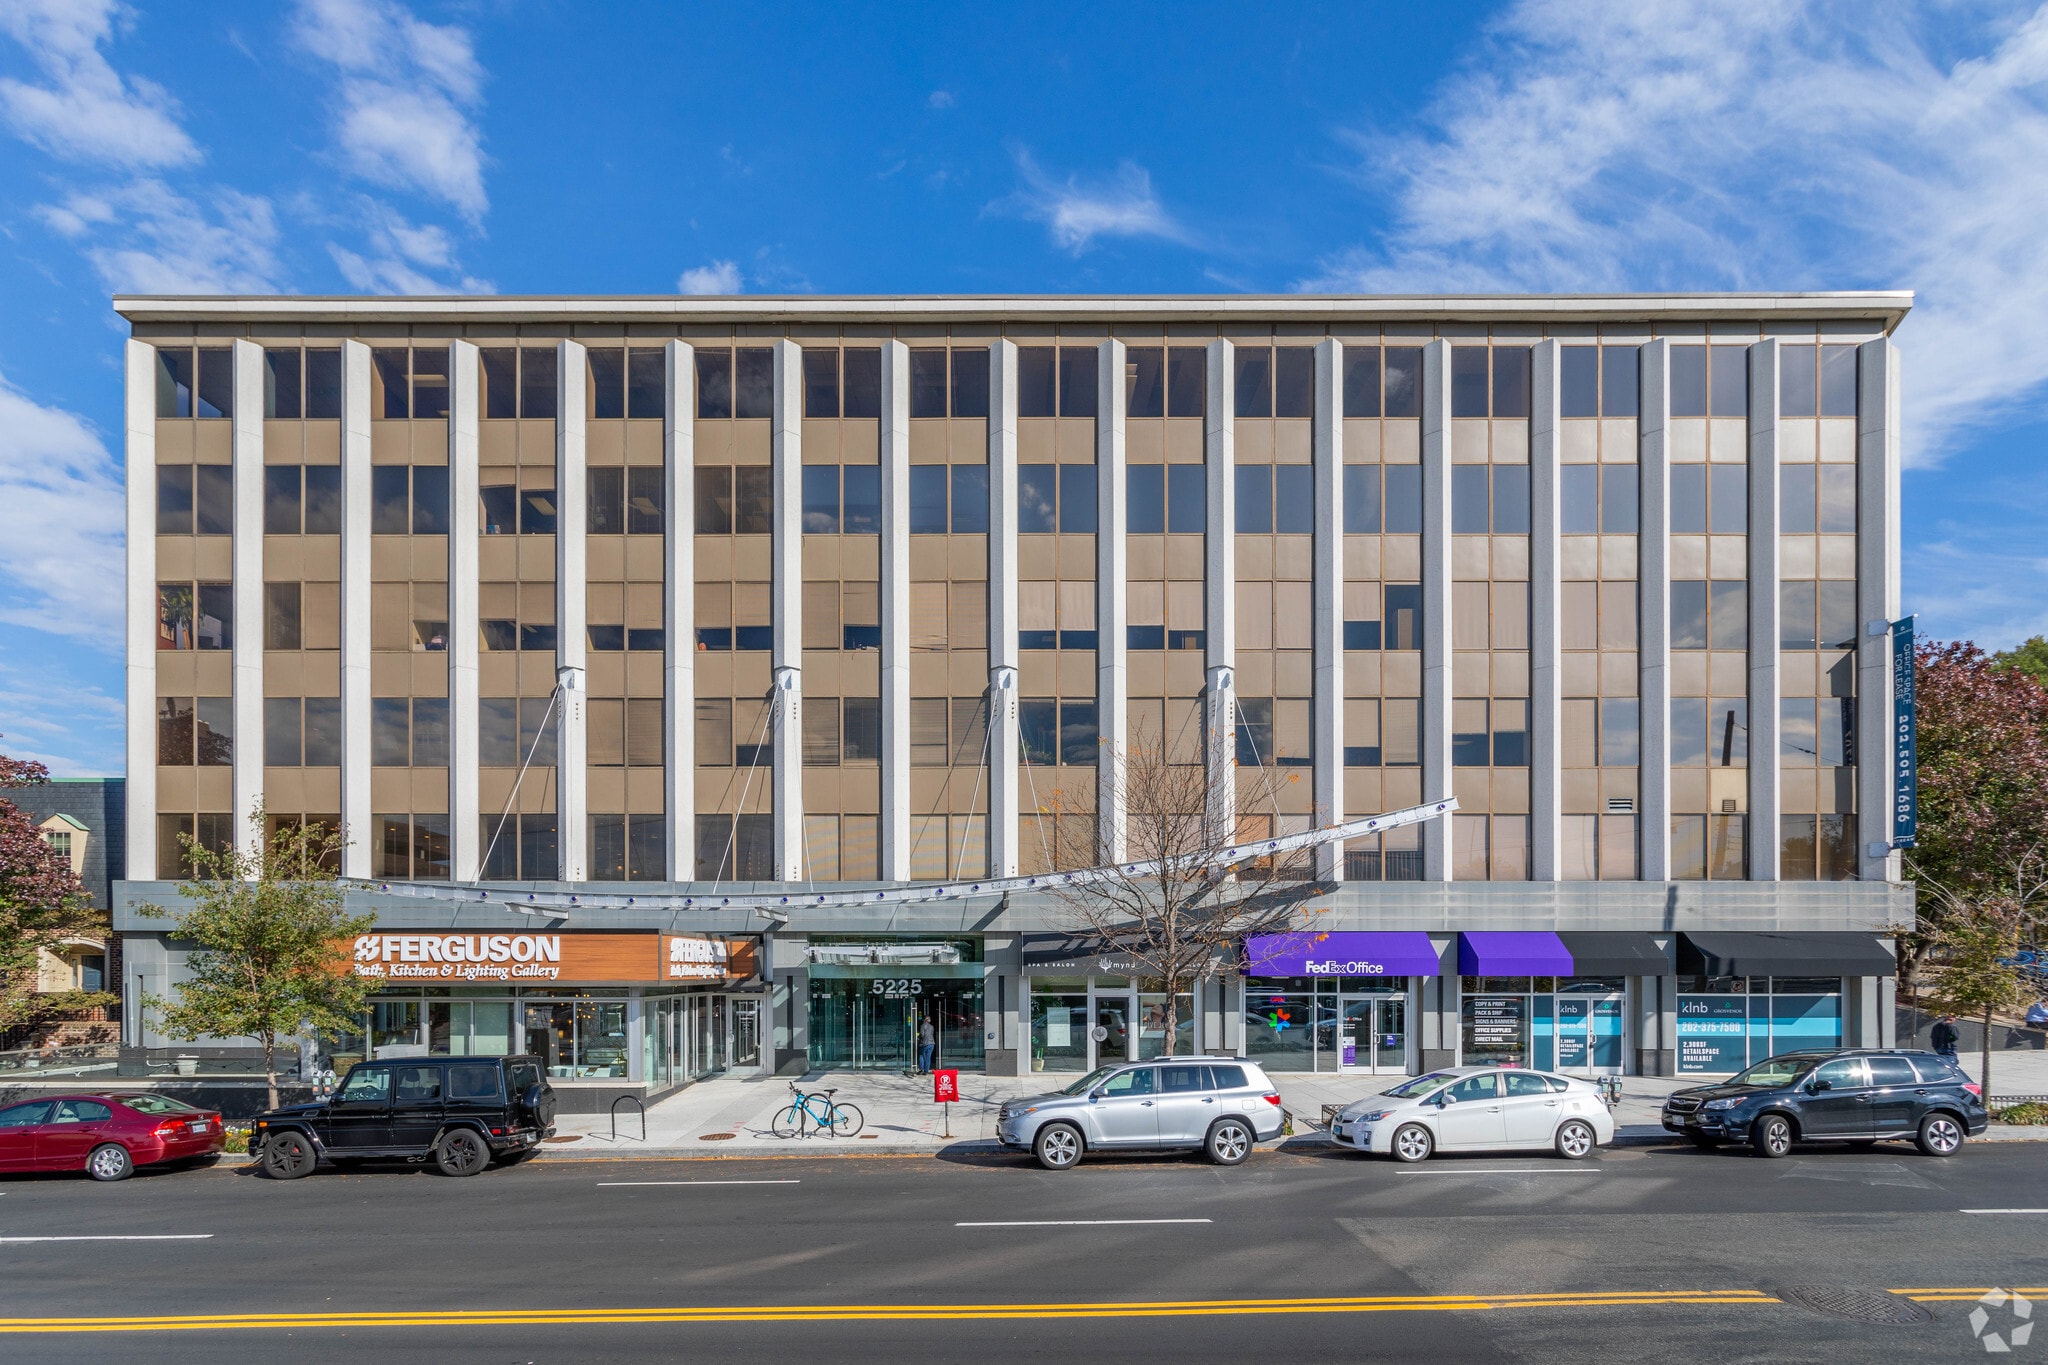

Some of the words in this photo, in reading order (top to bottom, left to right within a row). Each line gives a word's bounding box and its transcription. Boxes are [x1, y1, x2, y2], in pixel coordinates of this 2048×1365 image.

[1895, 653, 1903, 673] FOR
[1903, 643, 1911, 675] OFFICE
[1895, 674, 1904, 700] LEASE
[1903, 677, 1912, 705] SPACE
[1898, 715, 1910, 823] 202.505.1686
[381, 936, 560, 962] FERGUSON
[389, 964, 438, 977] Kitchen
[440, 964, 452, 977] &
[455, 964, 509, 980] Lighting
[511, 964, 560, 980] Gallery
[1305, 960, 1346, 974] FedEx
[1346, 961, 1384, 974] Office
[872, 979, 922, 994] 5225
[1682, 1001, 1708, 1013] klnb
[1682, 1021, 1741, 1032] 202-375-7500
